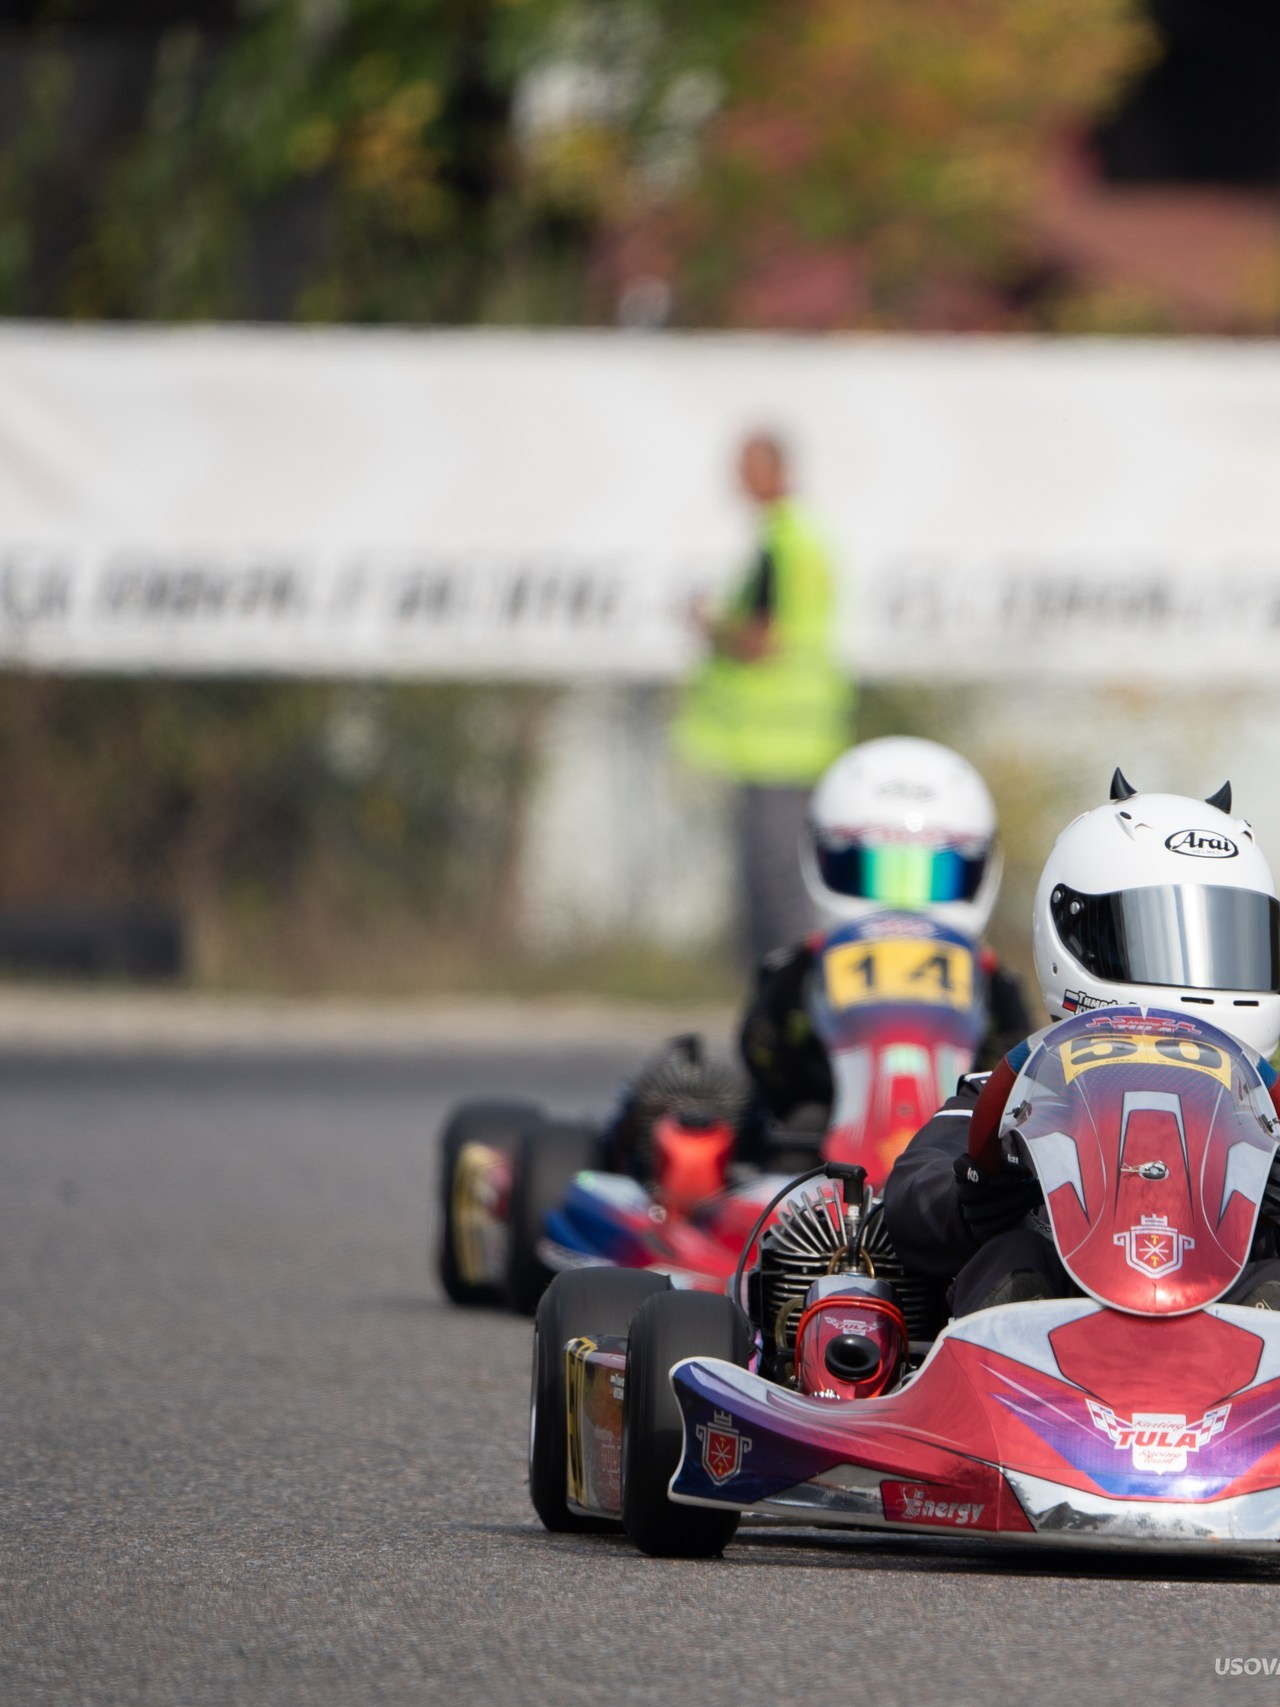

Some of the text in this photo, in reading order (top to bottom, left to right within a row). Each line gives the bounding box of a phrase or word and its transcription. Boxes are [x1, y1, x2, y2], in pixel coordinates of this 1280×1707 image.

[1171, 832, 1231, 851] Arai
[850, 954, 954, 990] 14
[1071, 1035, 1223, 1069] 50
[1119, 1431, 1196, 1448] TULA
[902, 1488, 985, 1524] Energy
